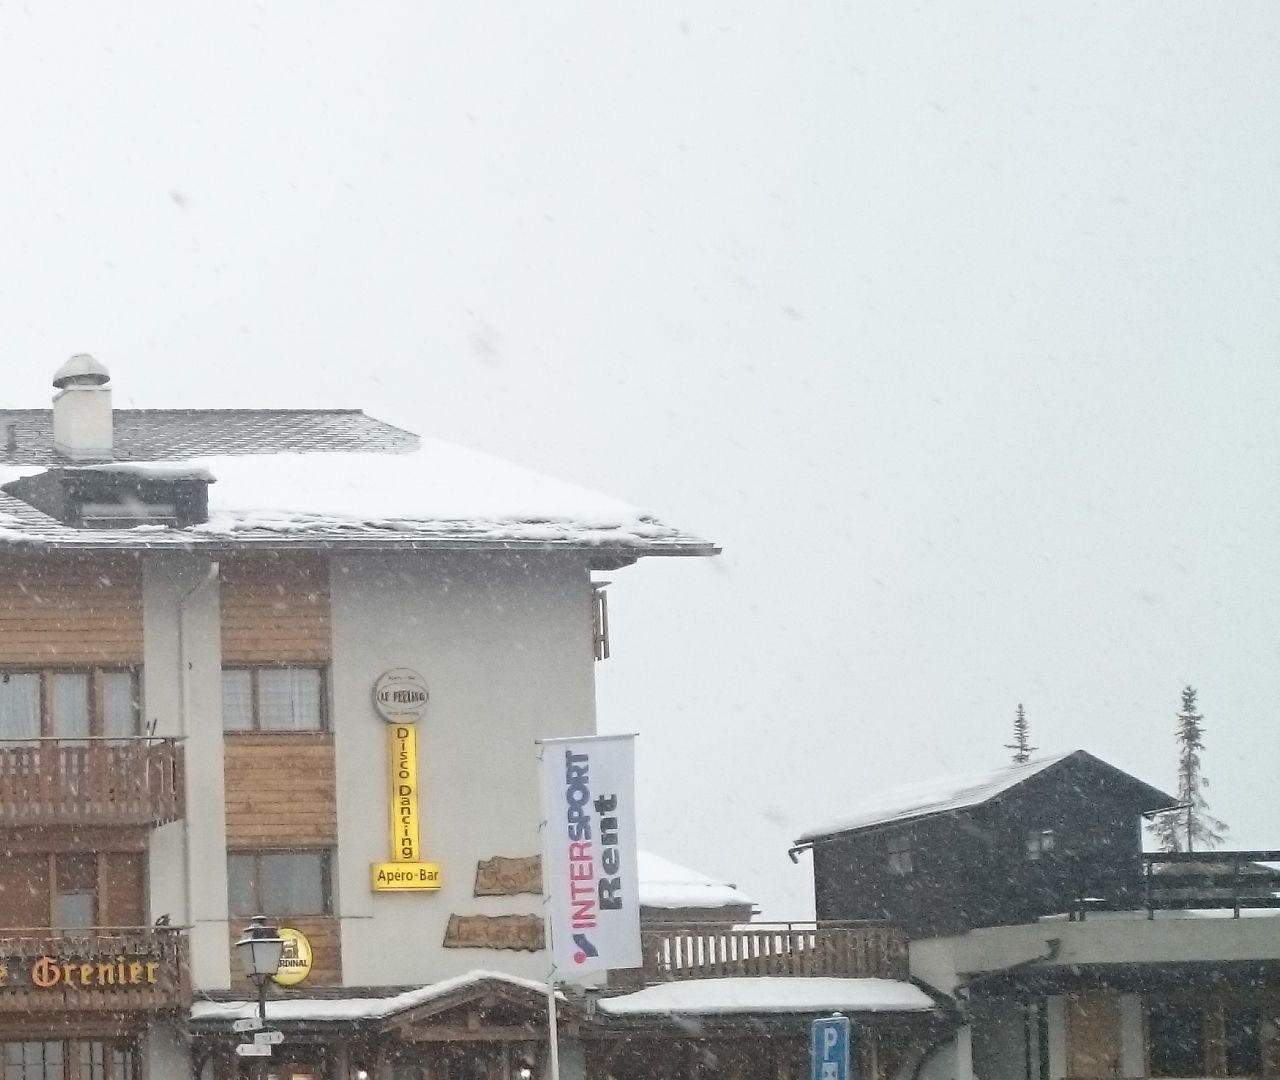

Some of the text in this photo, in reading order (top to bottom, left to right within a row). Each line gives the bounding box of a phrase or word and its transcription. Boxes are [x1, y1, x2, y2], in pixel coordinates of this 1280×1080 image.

[397, 728, 412, 859] Disco Dancing
[377, 868, 439, 885] Apéro-Bar
[566, 750, 598, 929] INTERSPORT
[593, 793, 623, 910] Rent
[32, 956, 160, 987] Grenier
[824, 1027, 838, 1061] P
